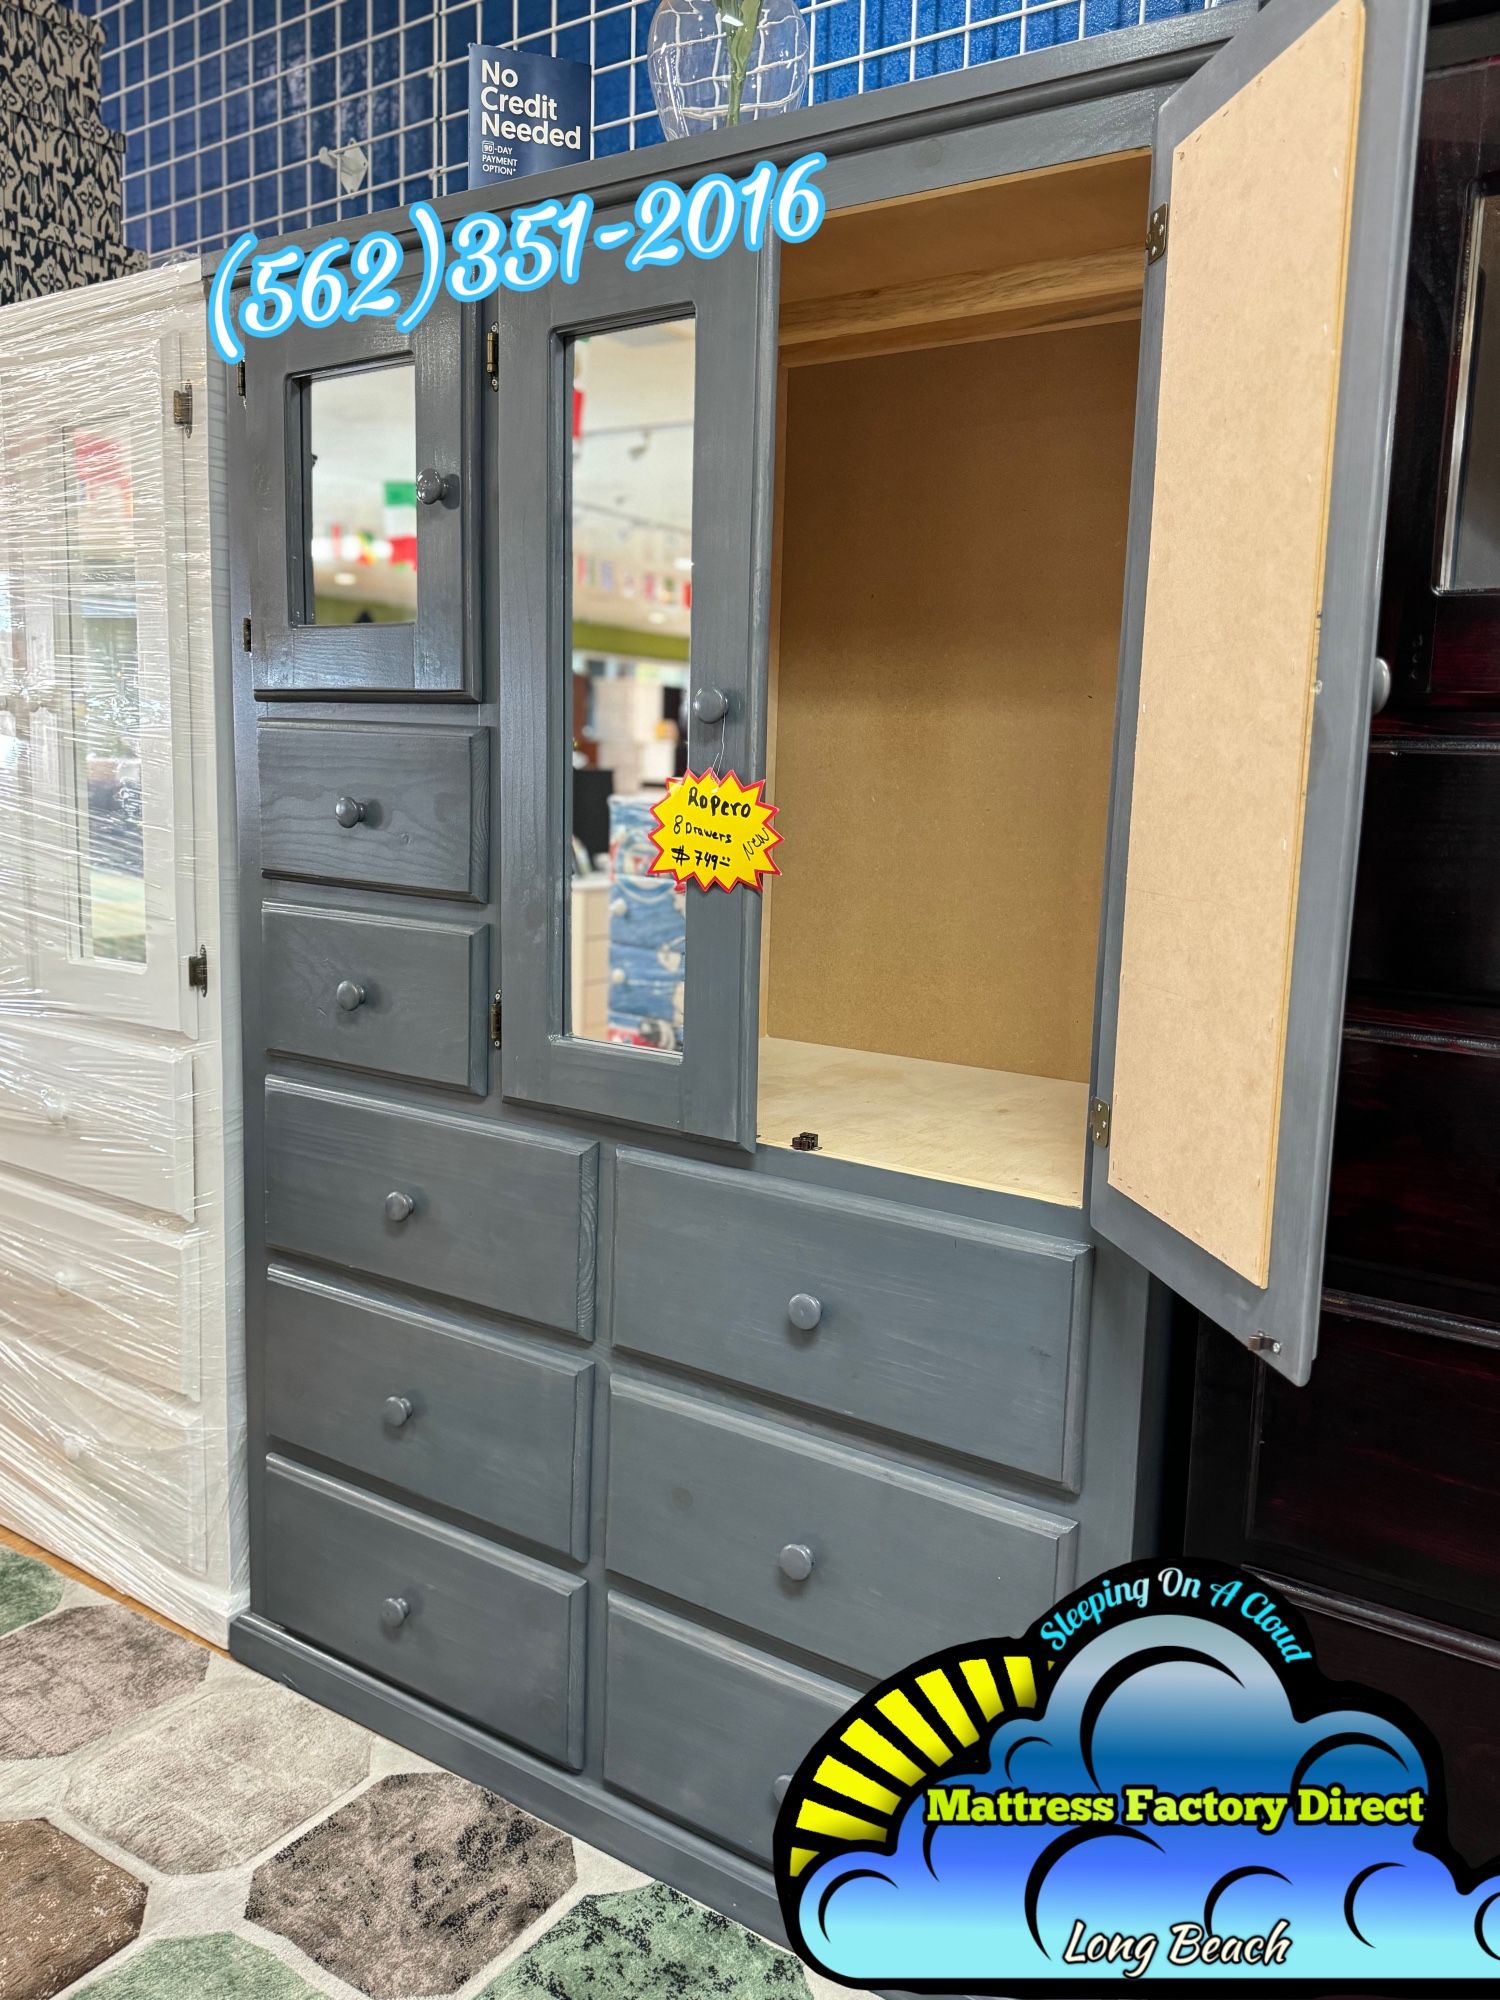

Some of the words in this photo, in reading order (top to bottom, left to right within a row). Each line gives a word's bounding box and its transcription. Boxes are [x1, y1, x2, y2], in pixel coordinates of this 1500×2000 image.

[481, 59, 519, 88] No
[480, 86, 558, 121] Credit
[481, 111, 581, 150] Needed
[482, 154, 518, 167] PAYMENT
[673, 815, 683, 835] 8
